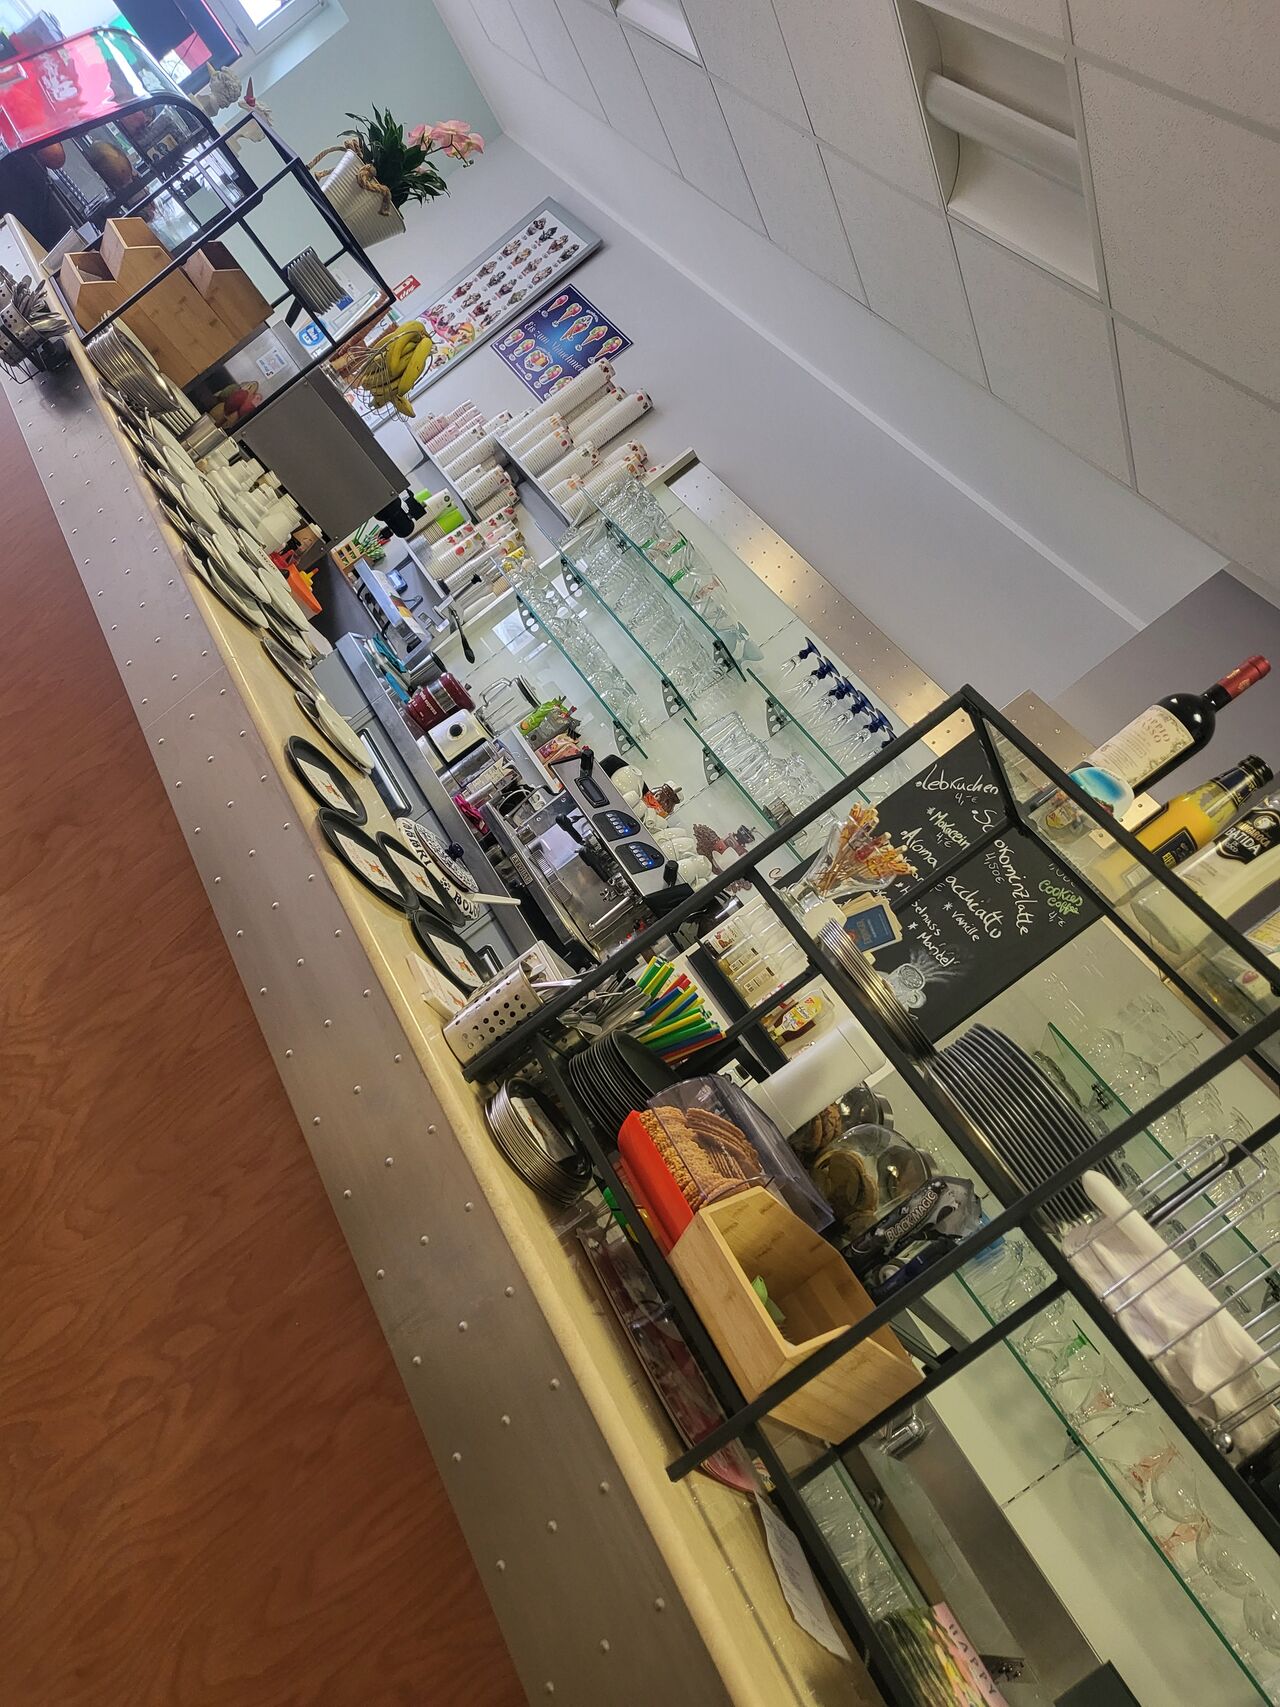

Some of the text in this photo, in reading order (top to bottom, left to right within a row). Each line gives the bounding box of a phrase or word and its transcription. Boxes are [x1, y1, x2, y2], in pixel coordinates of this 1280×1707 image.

[1224, 827, 1261, 856] BATIDA
[884, 1189, 938, 1243] BLACK MAGIC
[948, 1623, 997, 1695] HAPPY
